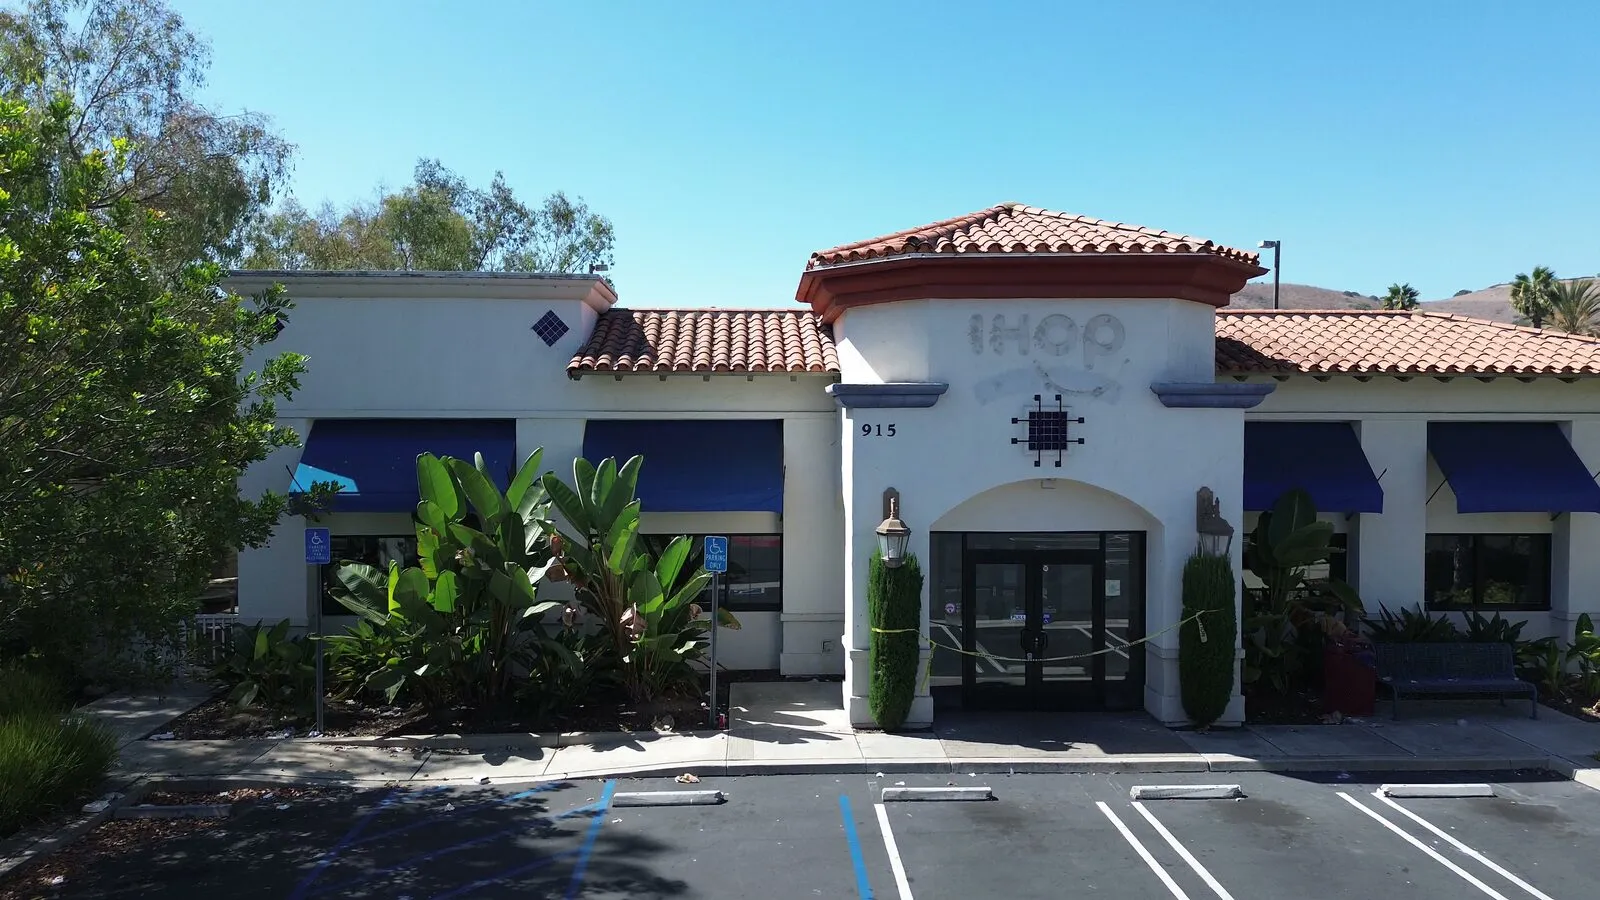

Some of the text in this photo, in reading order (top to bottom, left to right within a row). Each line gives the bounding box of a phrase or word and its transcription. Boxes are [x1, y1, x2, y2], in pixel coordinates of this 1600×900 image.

[968, 313, 1126, 370] IHOP
[861, 423, 896, 437] 915
[705, 553, 726, 561] PARKING
